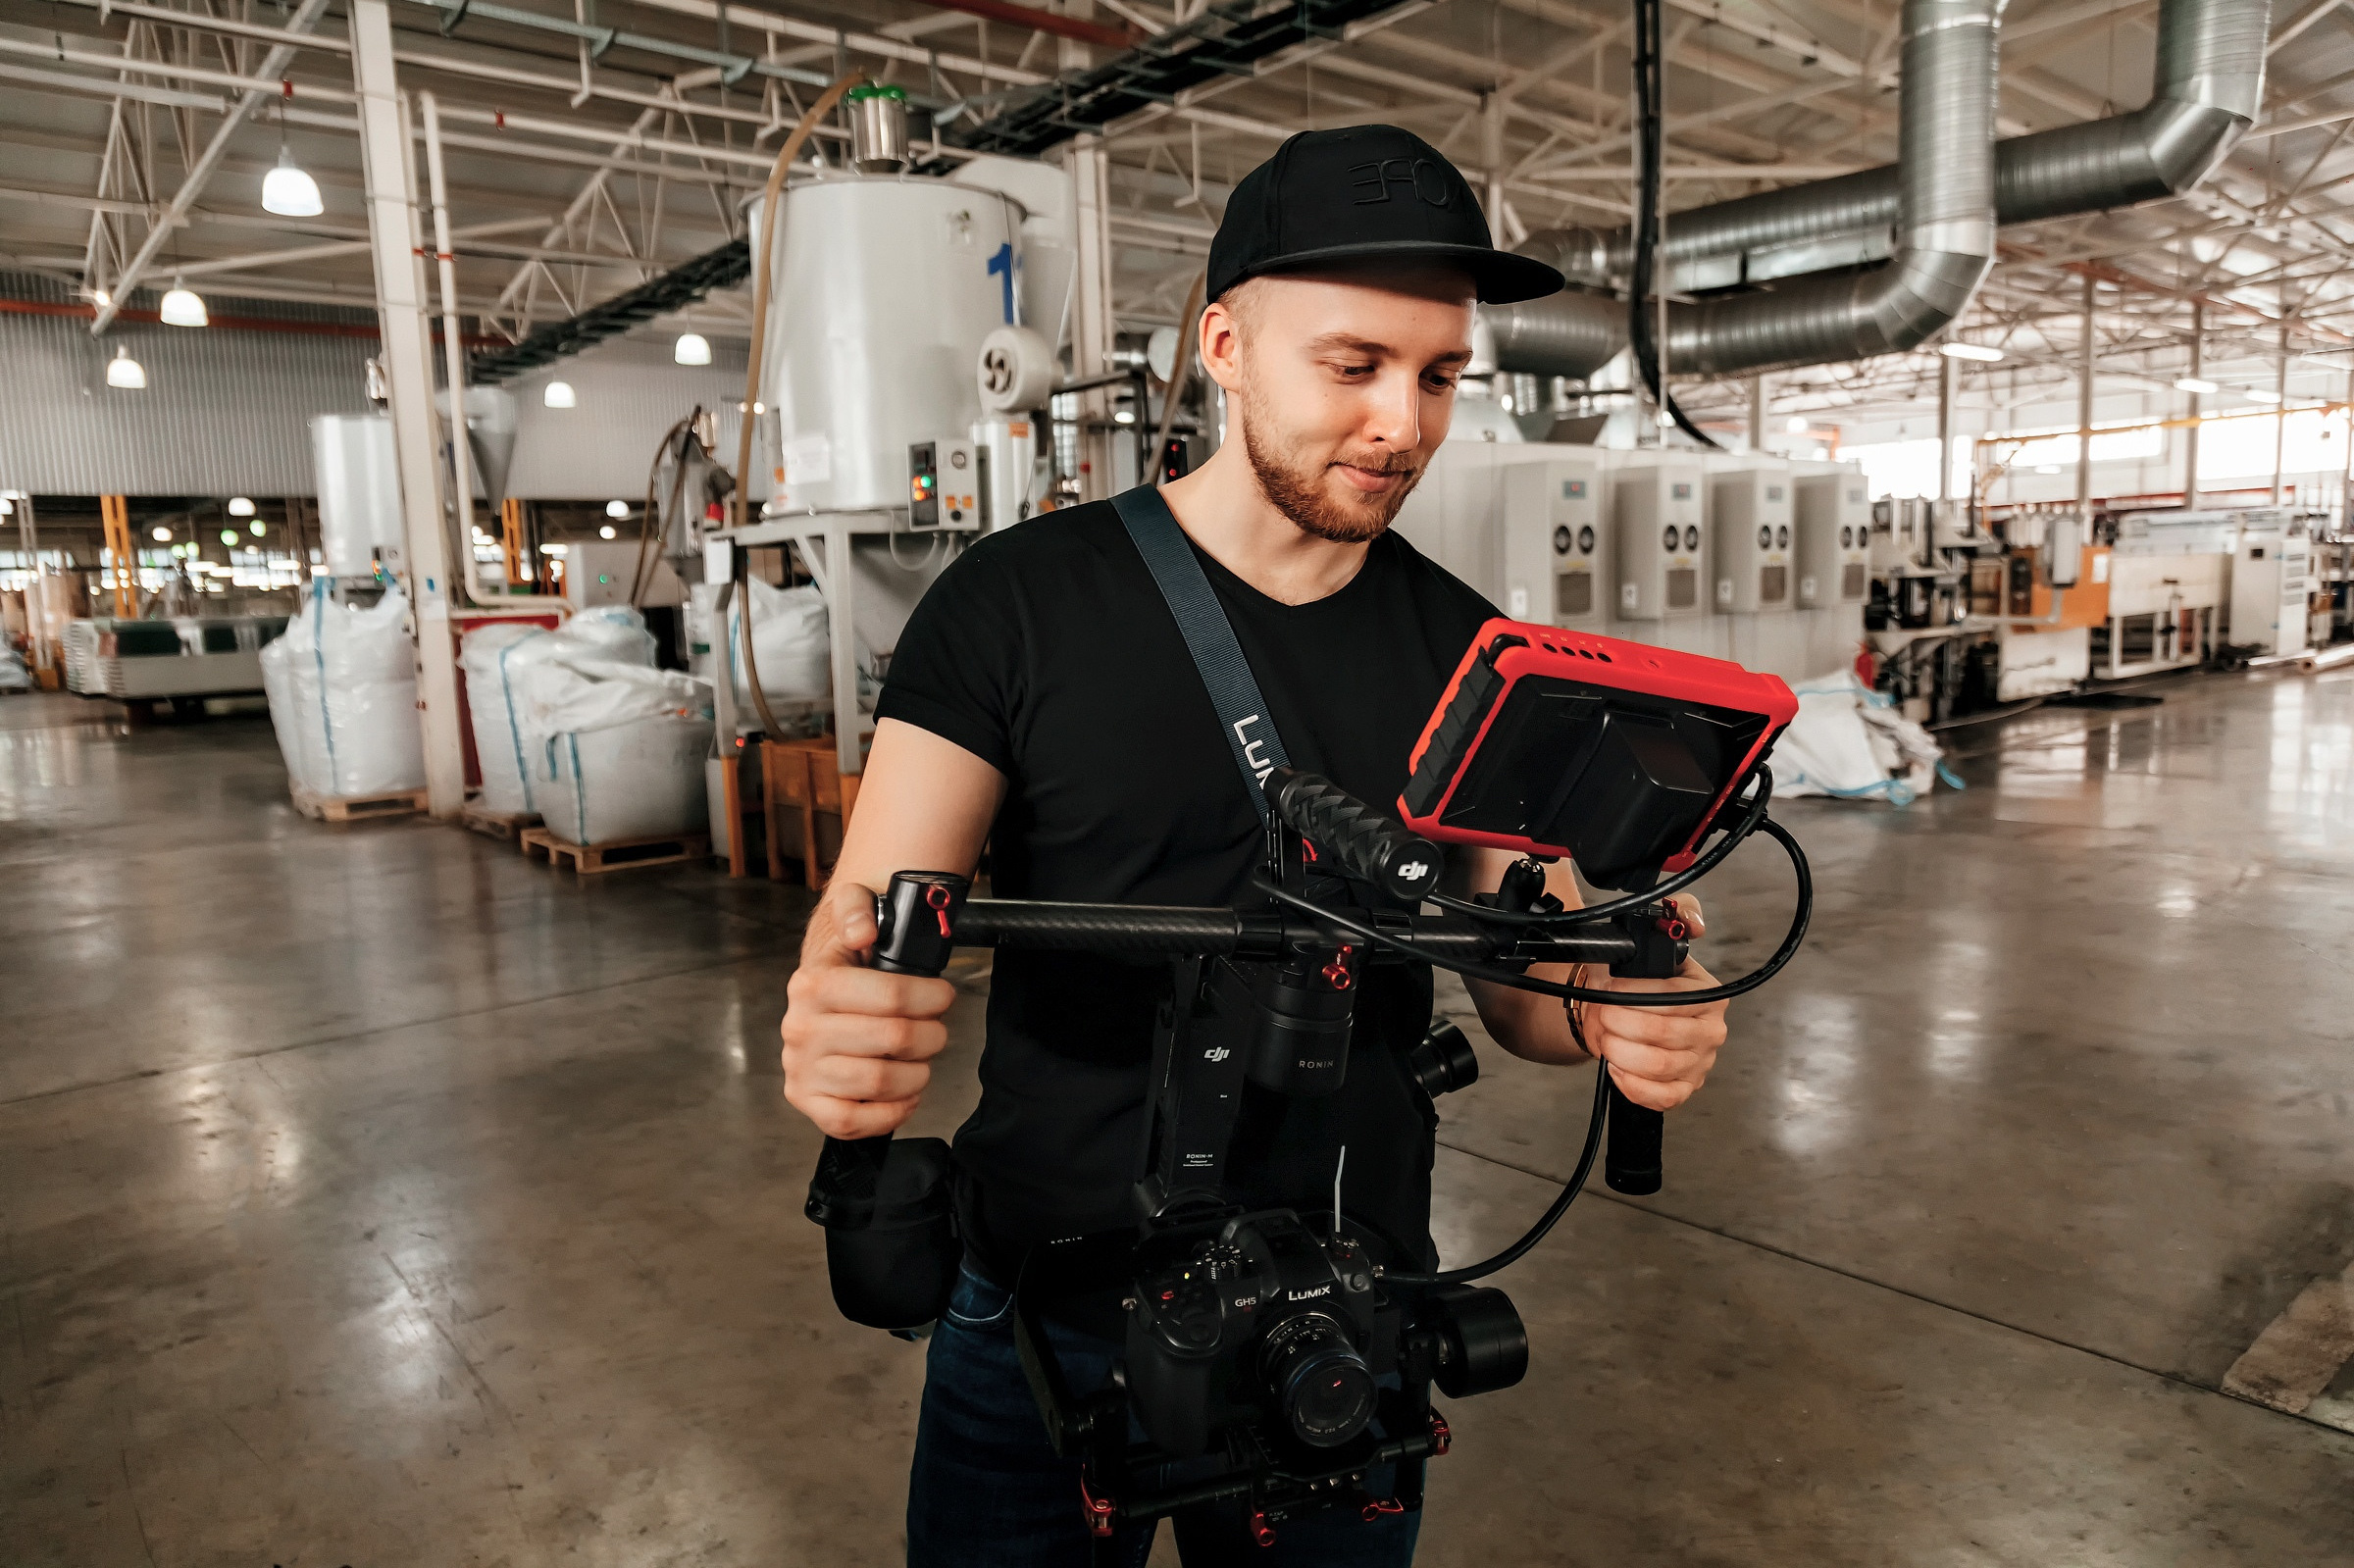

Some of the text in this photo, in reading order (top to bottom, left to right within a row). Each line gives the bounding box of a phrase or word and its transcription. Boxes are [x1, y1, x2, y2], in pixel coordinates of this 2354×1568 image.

[986, 241, 1014, 326] 1
[1298, 1059, 1335, 1069] RONIN
[1287, 1286, 1331, 1301] LUMIX
[1234, 1296, 1256, 1307] GH5
